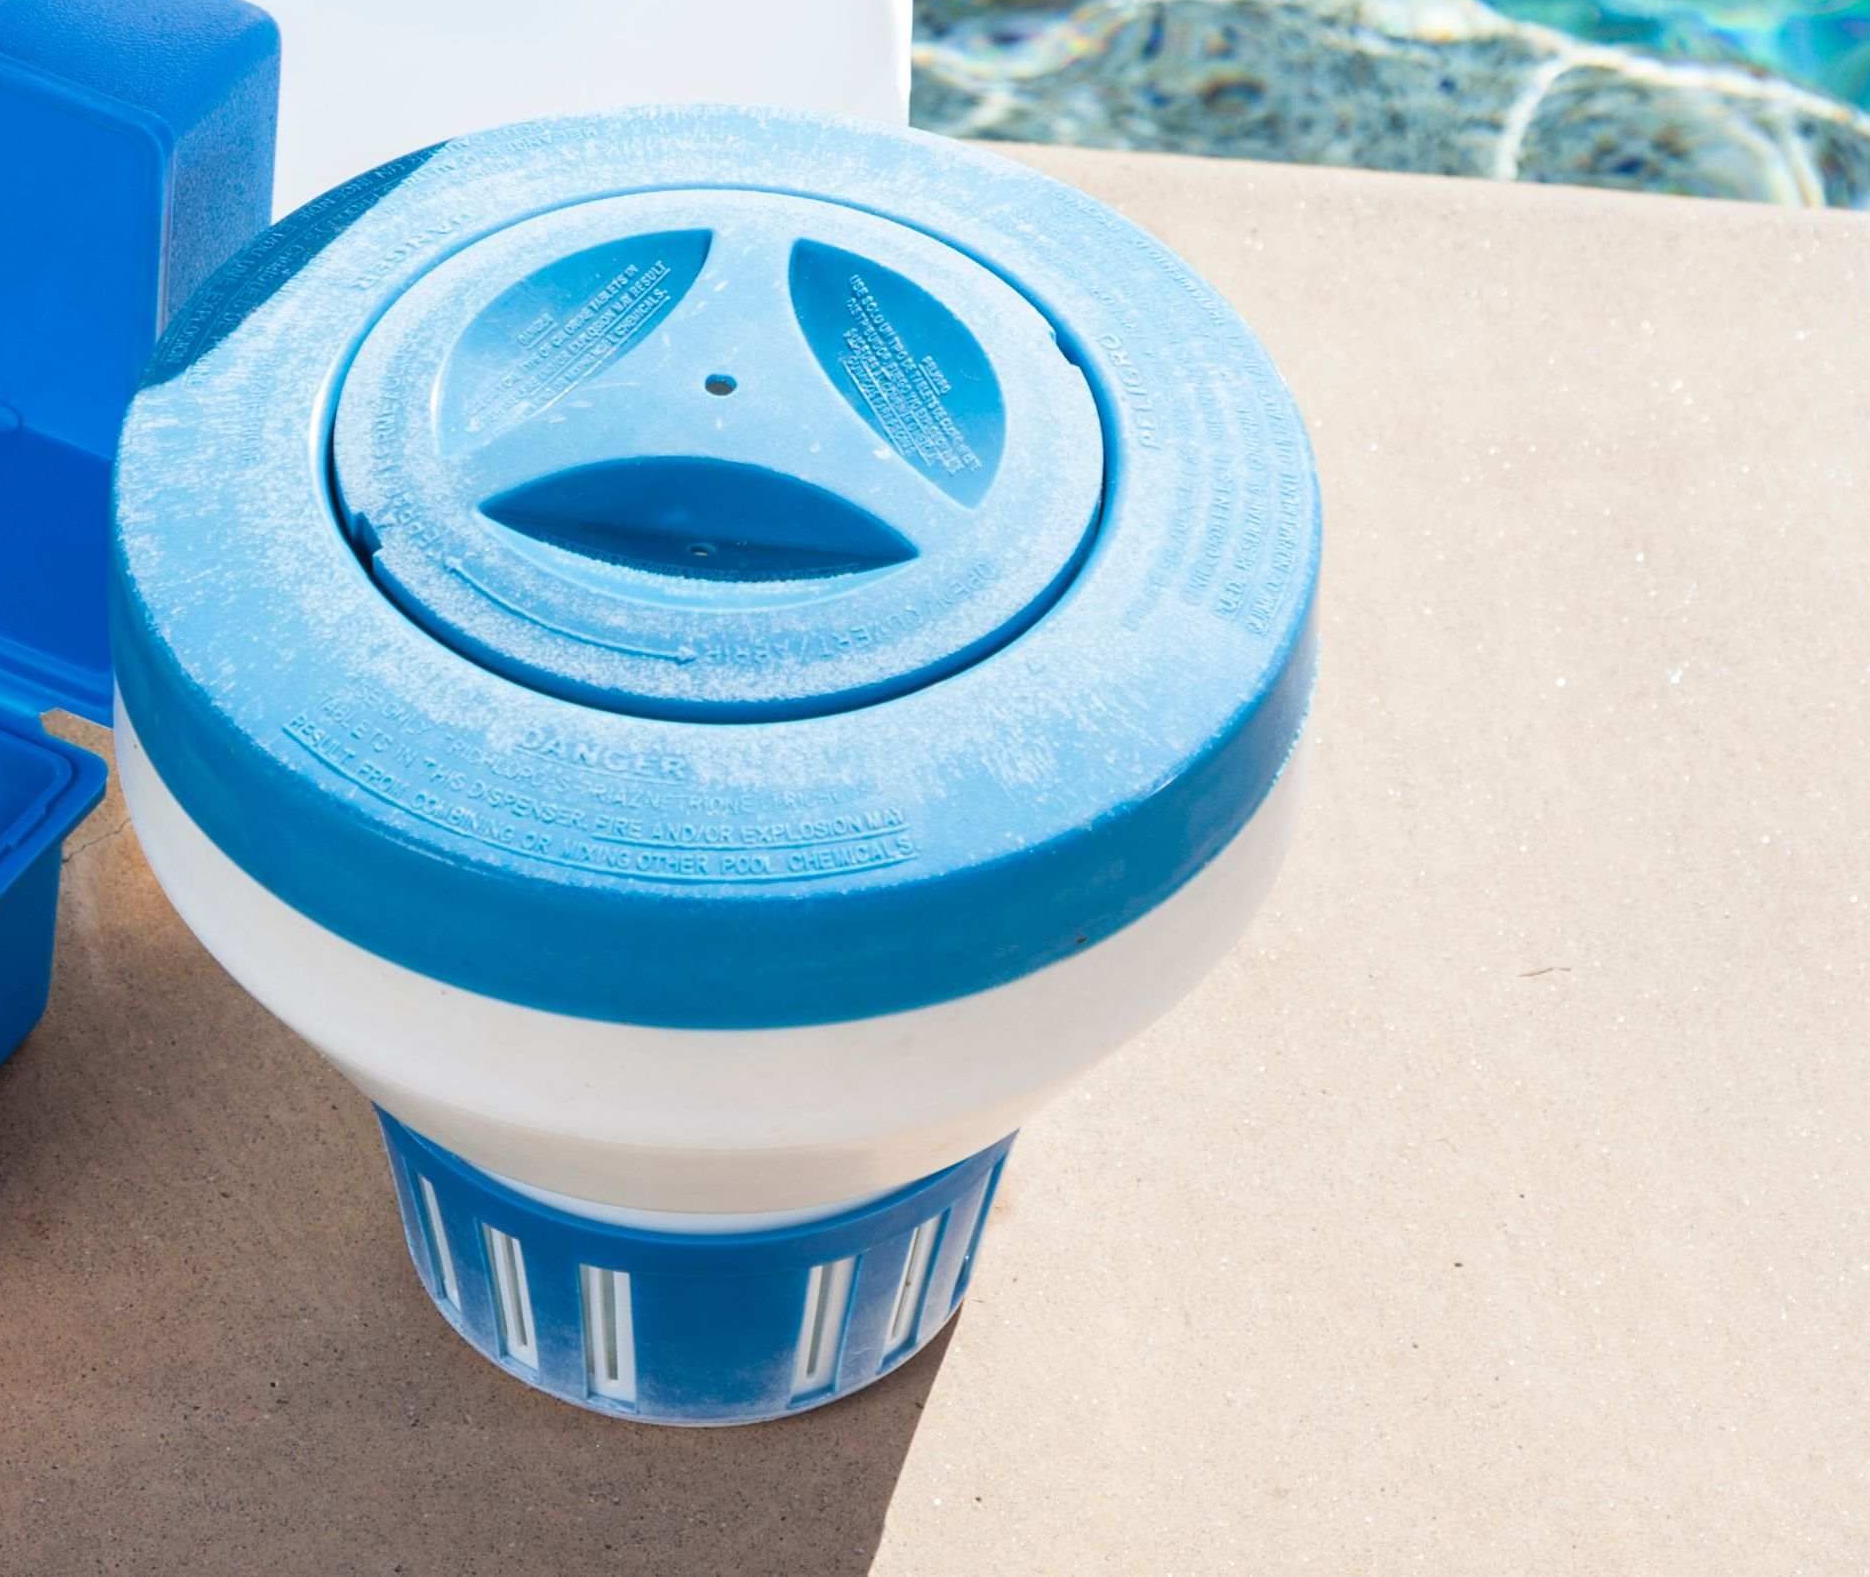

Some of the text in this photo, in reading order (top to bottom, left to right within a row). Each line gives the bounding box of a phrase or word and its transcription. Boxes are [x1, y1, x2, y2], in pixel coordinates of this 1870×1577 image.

[587, 272, 629, 312] TABLETS
[627, 259, 668, 297] RESULT
[846, 272, 869, 298] USE
[859, 293, 886, 324] SOLO
[514, 723, 687, 778] DANGER
[284, 711, 360, 768] RESULT
[350, 758, 411, 800] FROM
[406, 788, 521, 845] COMBINING
[517, 827, 556, 856] OR
[557, 836, 633, 870] MIXING
[633, 849, 709, 876] OTHER
[720, 853, 778, 876] POOL
[412, 755, 472, 795] THIS
[590, 812, 644, 839] FIRE
[648, 820, 735, 844] AND/OR
[739, 811, 866, 844] EXPLOSION
[861, 803, 907, 831] MAY
